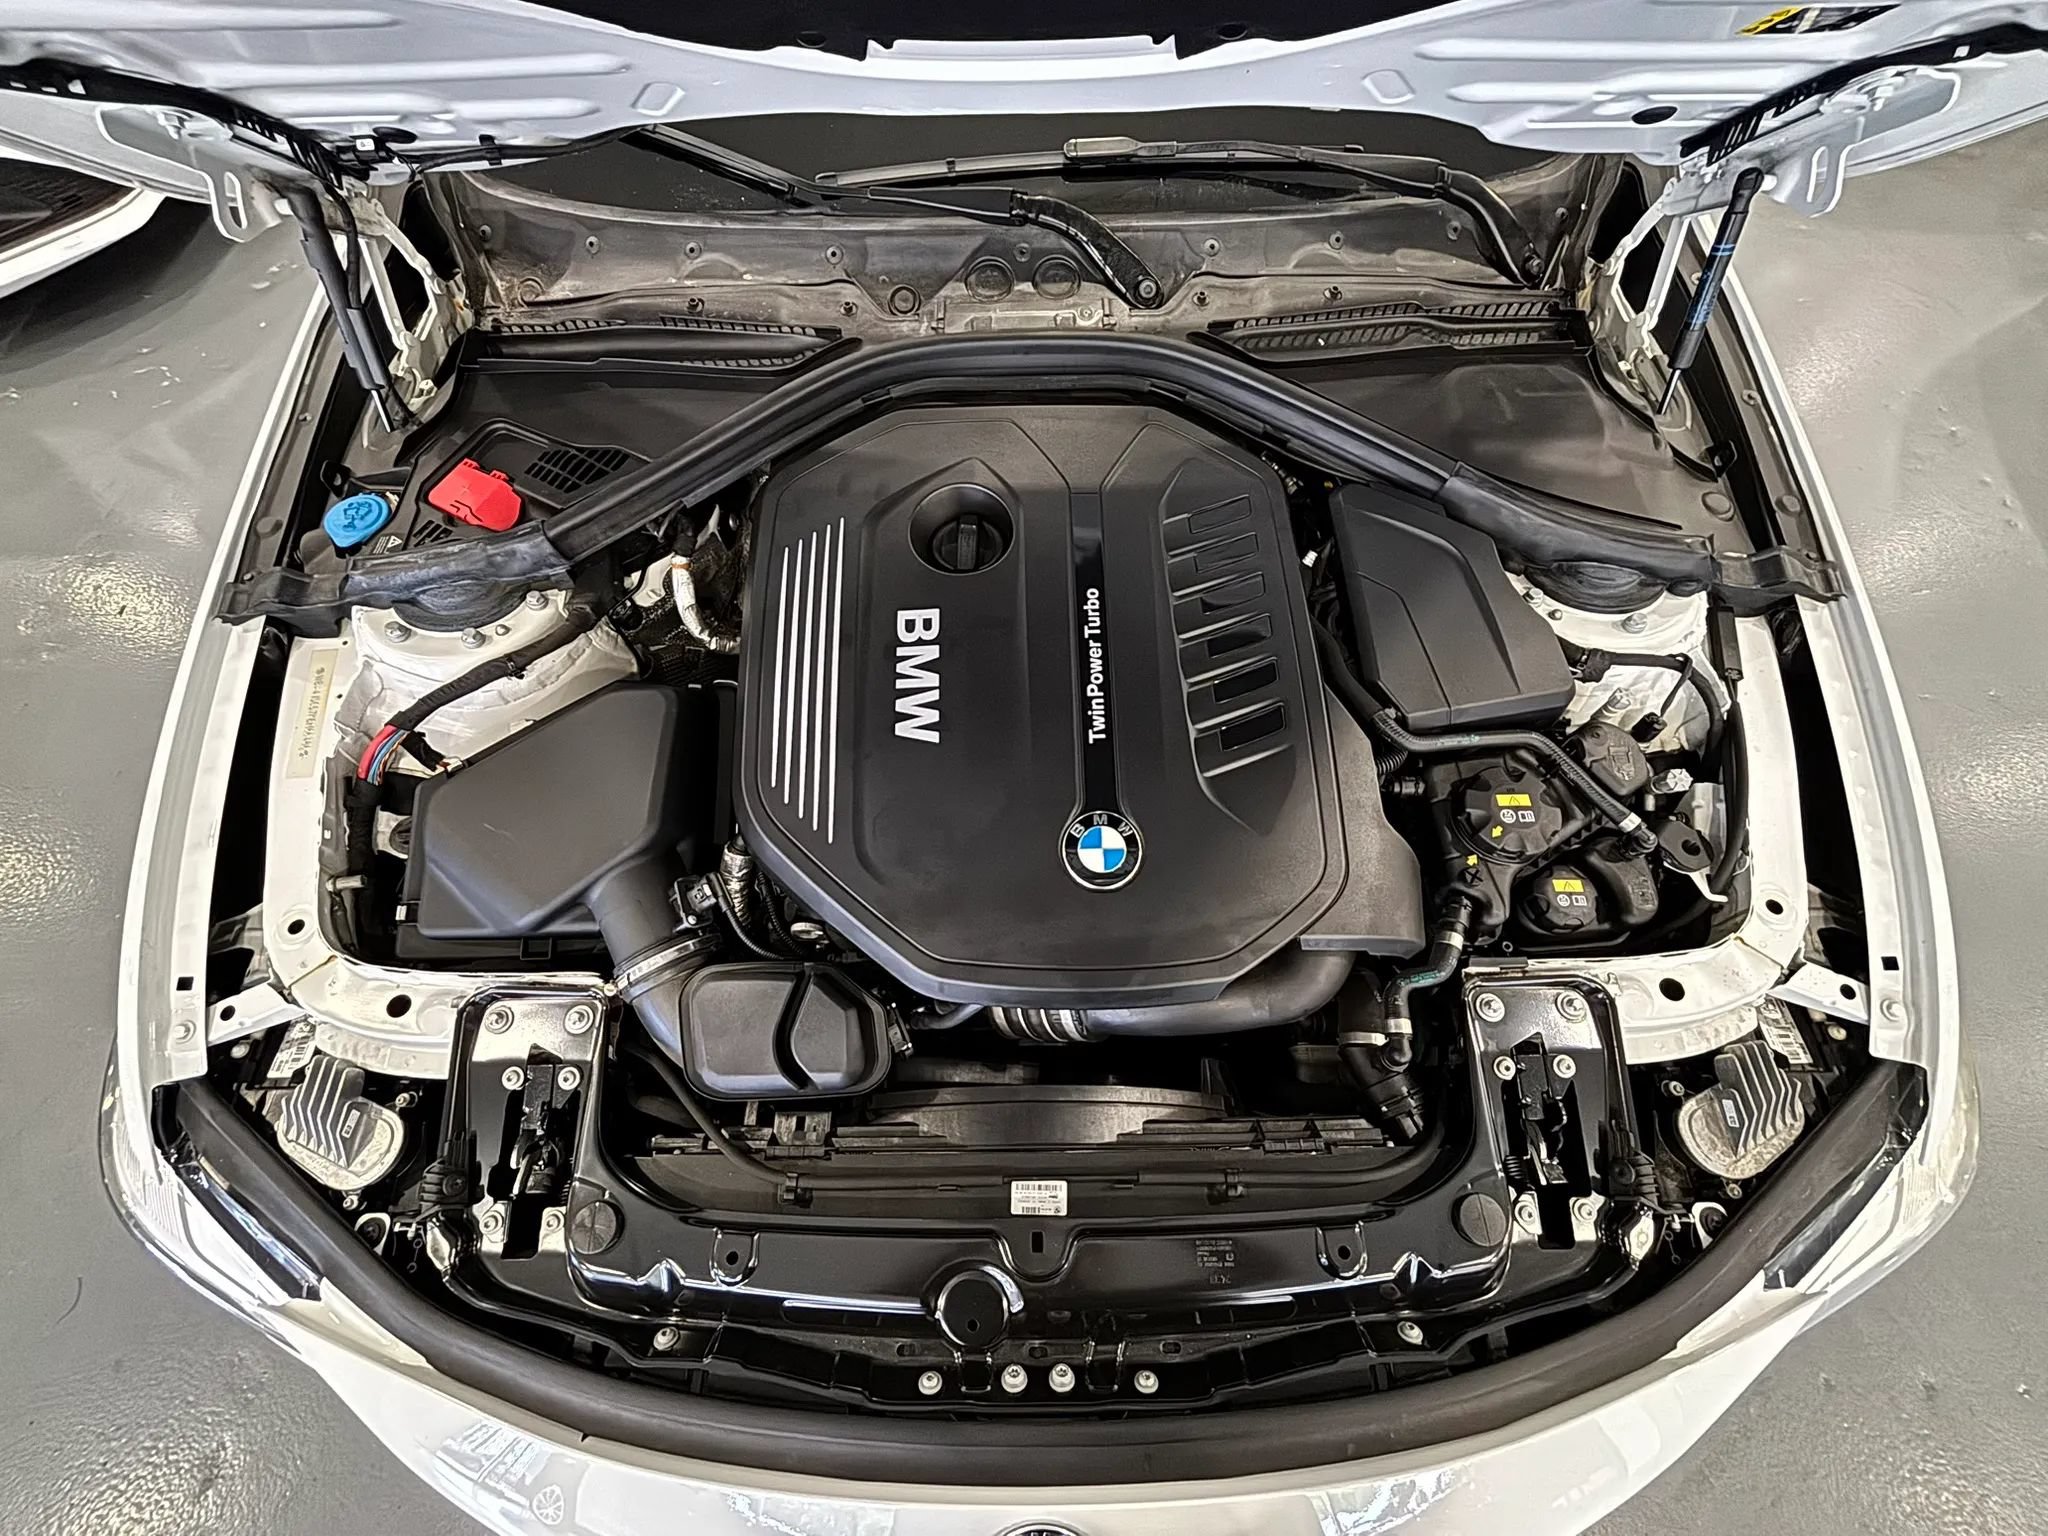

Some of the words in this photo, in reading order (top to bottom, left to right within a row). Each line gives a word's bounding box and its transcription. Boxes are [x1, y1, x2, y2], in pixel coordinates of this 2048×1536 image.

[1083, 587, 1101, 639] Turbo
[895, 608, 940, 744] BMW
[1069, 814, 1133, 838] BMW
